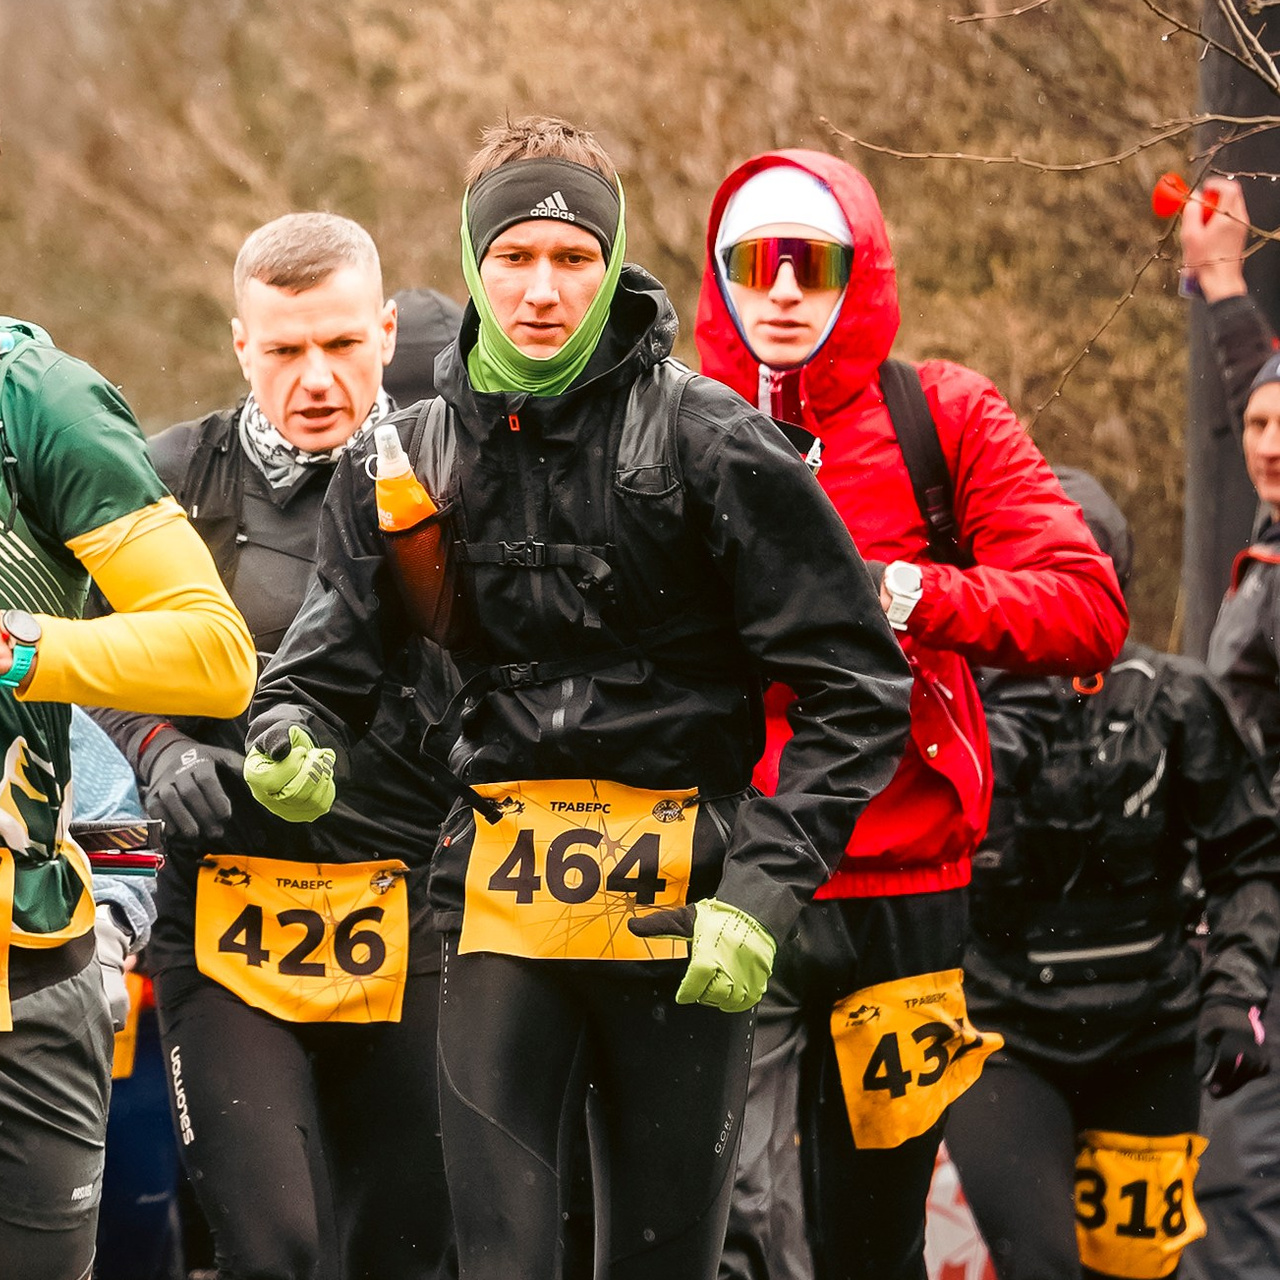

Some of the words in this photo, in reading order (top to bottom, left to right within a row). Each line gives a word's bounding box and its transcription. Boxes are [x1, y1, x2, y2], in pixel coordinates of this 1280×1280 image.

[530, 207, 575, 221] adidas
[549, 801, 611, 814] ТРАВЕРС
[276, 877, 333, 890] ТРАВЕРС
[487, 828, 667, 905] 464
[218, 903, 386, 977] 426
[862, 1018, 983, 1100] 43
[1074, 1169, 1187, 1238] 318
